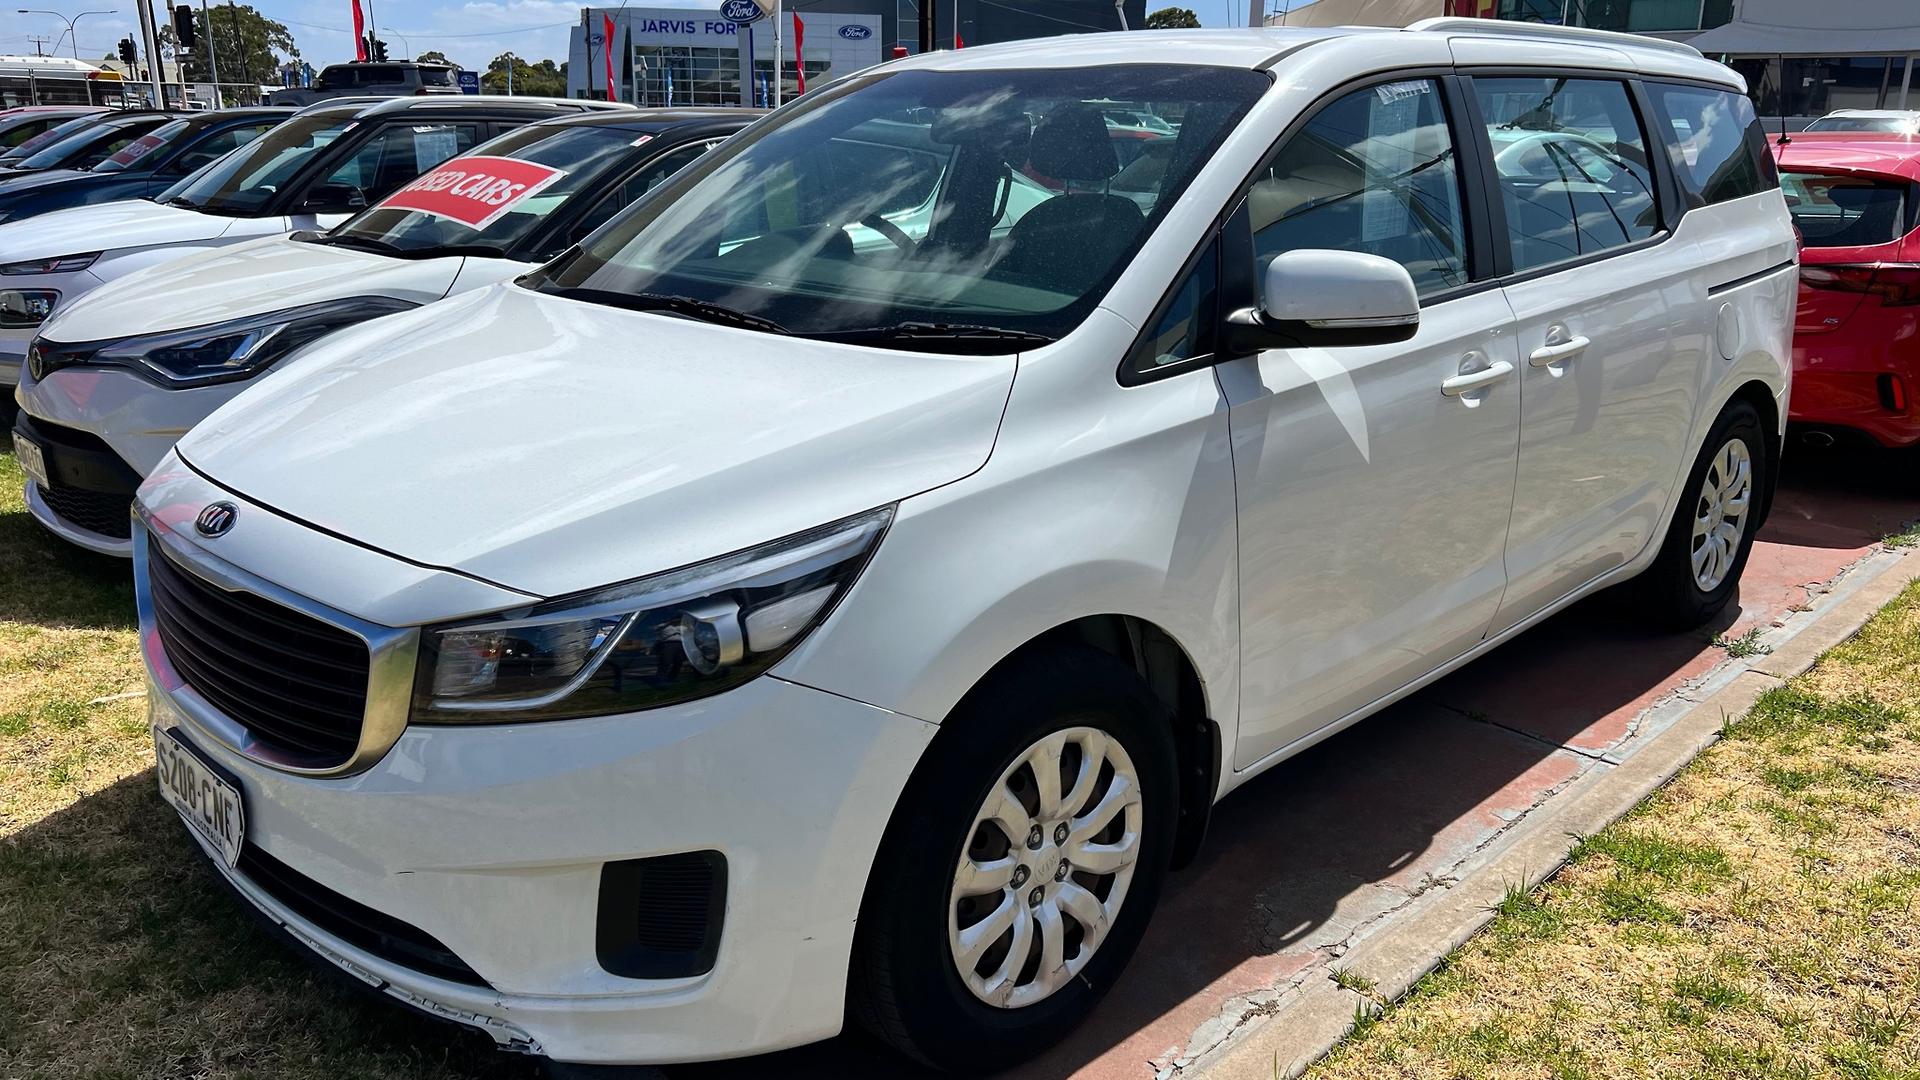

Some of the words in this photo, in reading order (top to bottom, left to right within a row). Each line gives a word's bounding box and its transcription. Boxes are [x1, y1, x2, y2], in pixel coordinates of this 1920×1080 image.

[728, 0, 754, 17] Ford
[641, 20, 696, 34] JARVIS
[705, 22, 739, 35] FOR
[406, 171, 467, 192] USED
[450, 173, 526, 205] CARS
[200, 505, 231, 531] KIA
